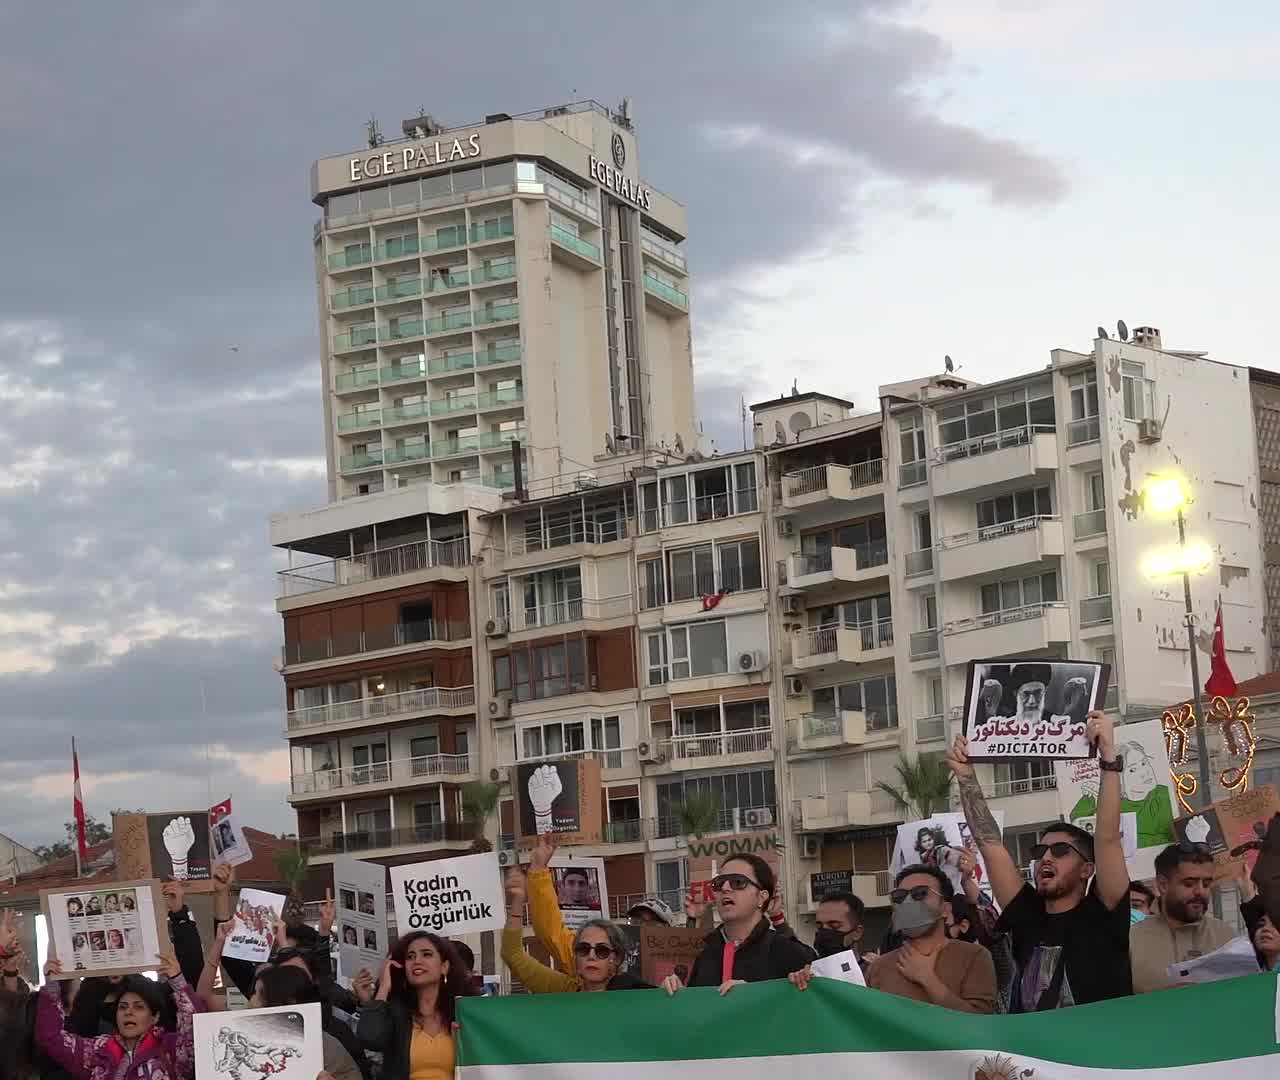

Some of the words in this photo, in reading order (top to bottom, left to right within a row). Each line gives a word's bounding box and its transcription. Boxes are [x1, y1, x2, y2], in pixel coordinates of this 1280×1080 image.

[350, 151, 394, 181] EGE
[403, 134, 481, 170] PALAS
[589, 154, 613, 187] EGE
[613, 167, 651, 210] PALAS
[971, 720, 1029, 741] دیکتاتور
[1030, 721, 1046, 741] بر
[1047, 720, 1085, 741] مرگ
[987, 743, 1067, 754] #DICTATOR
[688, 833, 777, 858] WOMAN
[404, 875, 458, 894] Kadın
[405, 889, 472, 911] Yaşam
[408, 902, 492, 930] Özgürlük
